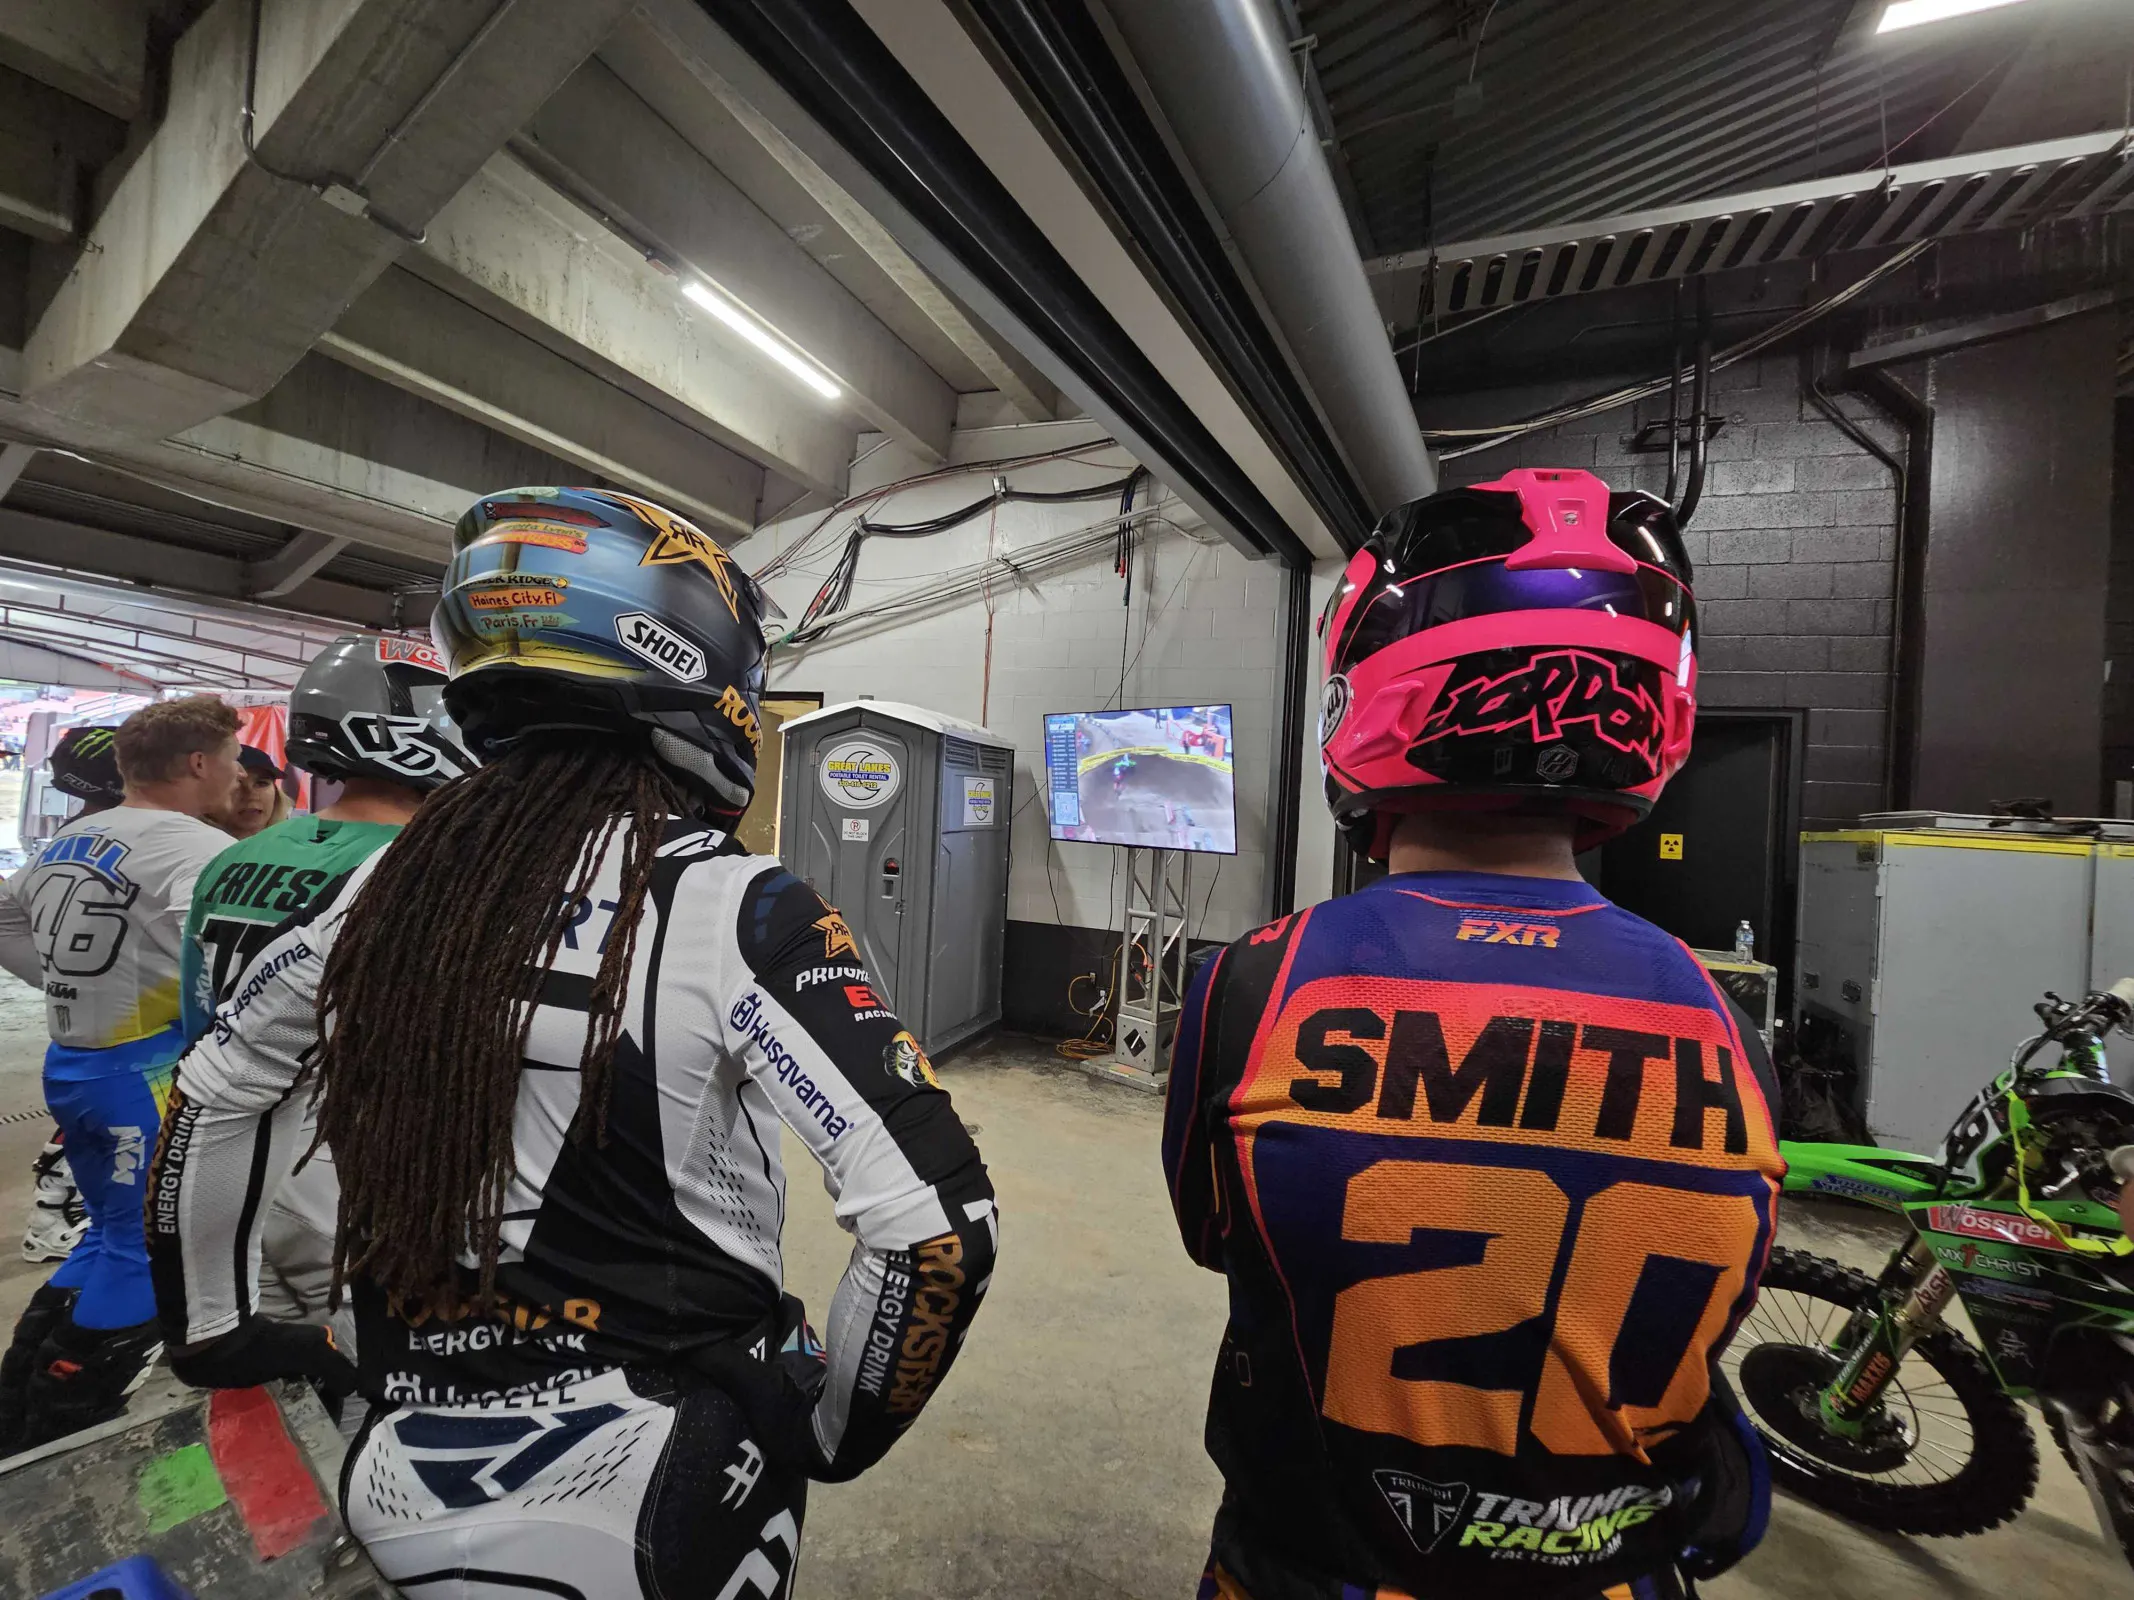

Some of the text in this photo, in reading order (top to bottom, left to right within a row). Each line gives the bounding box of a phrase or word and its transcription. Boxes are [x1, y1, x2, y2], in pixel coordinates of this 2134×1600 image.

[471, 594, 510, 607] Haines
[627, 621, 698, 676] SHOEI
[828, 761, 891, 774] GREAT LAKES
[31, 873, 140, 977] 46
[1456, 918, 1561, 949] FXR
[46, 981, 77, 1000] KTM
[748, 1014, 848, 1142] Husqvarna
[1289, 1006, 1750, 1156] SMITH
[168, 1104, 200, 1163] DRINK
[157, 1164, 181, 1234] ENERGY
[1975, 1254, 2043, 1278] CHRIST
[1322, 1159, 1760, 1466] 20
[858, 1330, 896, 1398] DRINK
[1391, 1476, 1453, 1502] TRIUMPH
[1458, 1505, 1658, 1555] RACING
